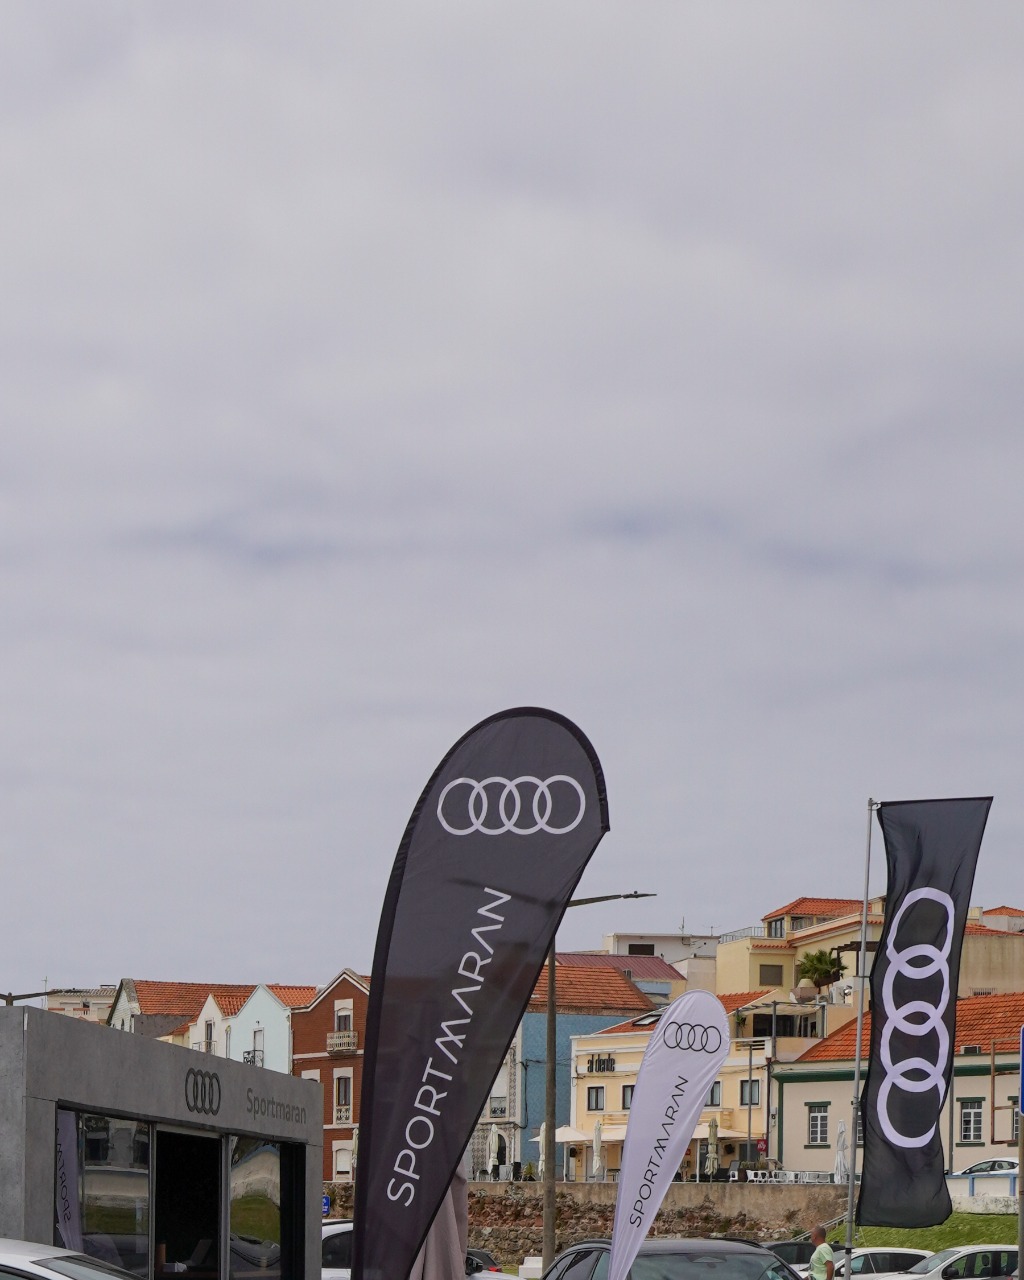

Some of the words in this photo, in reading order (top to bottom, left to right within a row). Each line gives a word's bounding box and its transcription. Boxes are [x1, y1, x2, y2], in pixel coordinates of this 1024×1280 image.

[387, 887, 511, 1207] SPORTMARAN
[595, 1053, 616, 1073] dente
[246, 1088, 307, 1124] Sportmaran
[630, 1075, 689, 1228] SPORTMARAN
